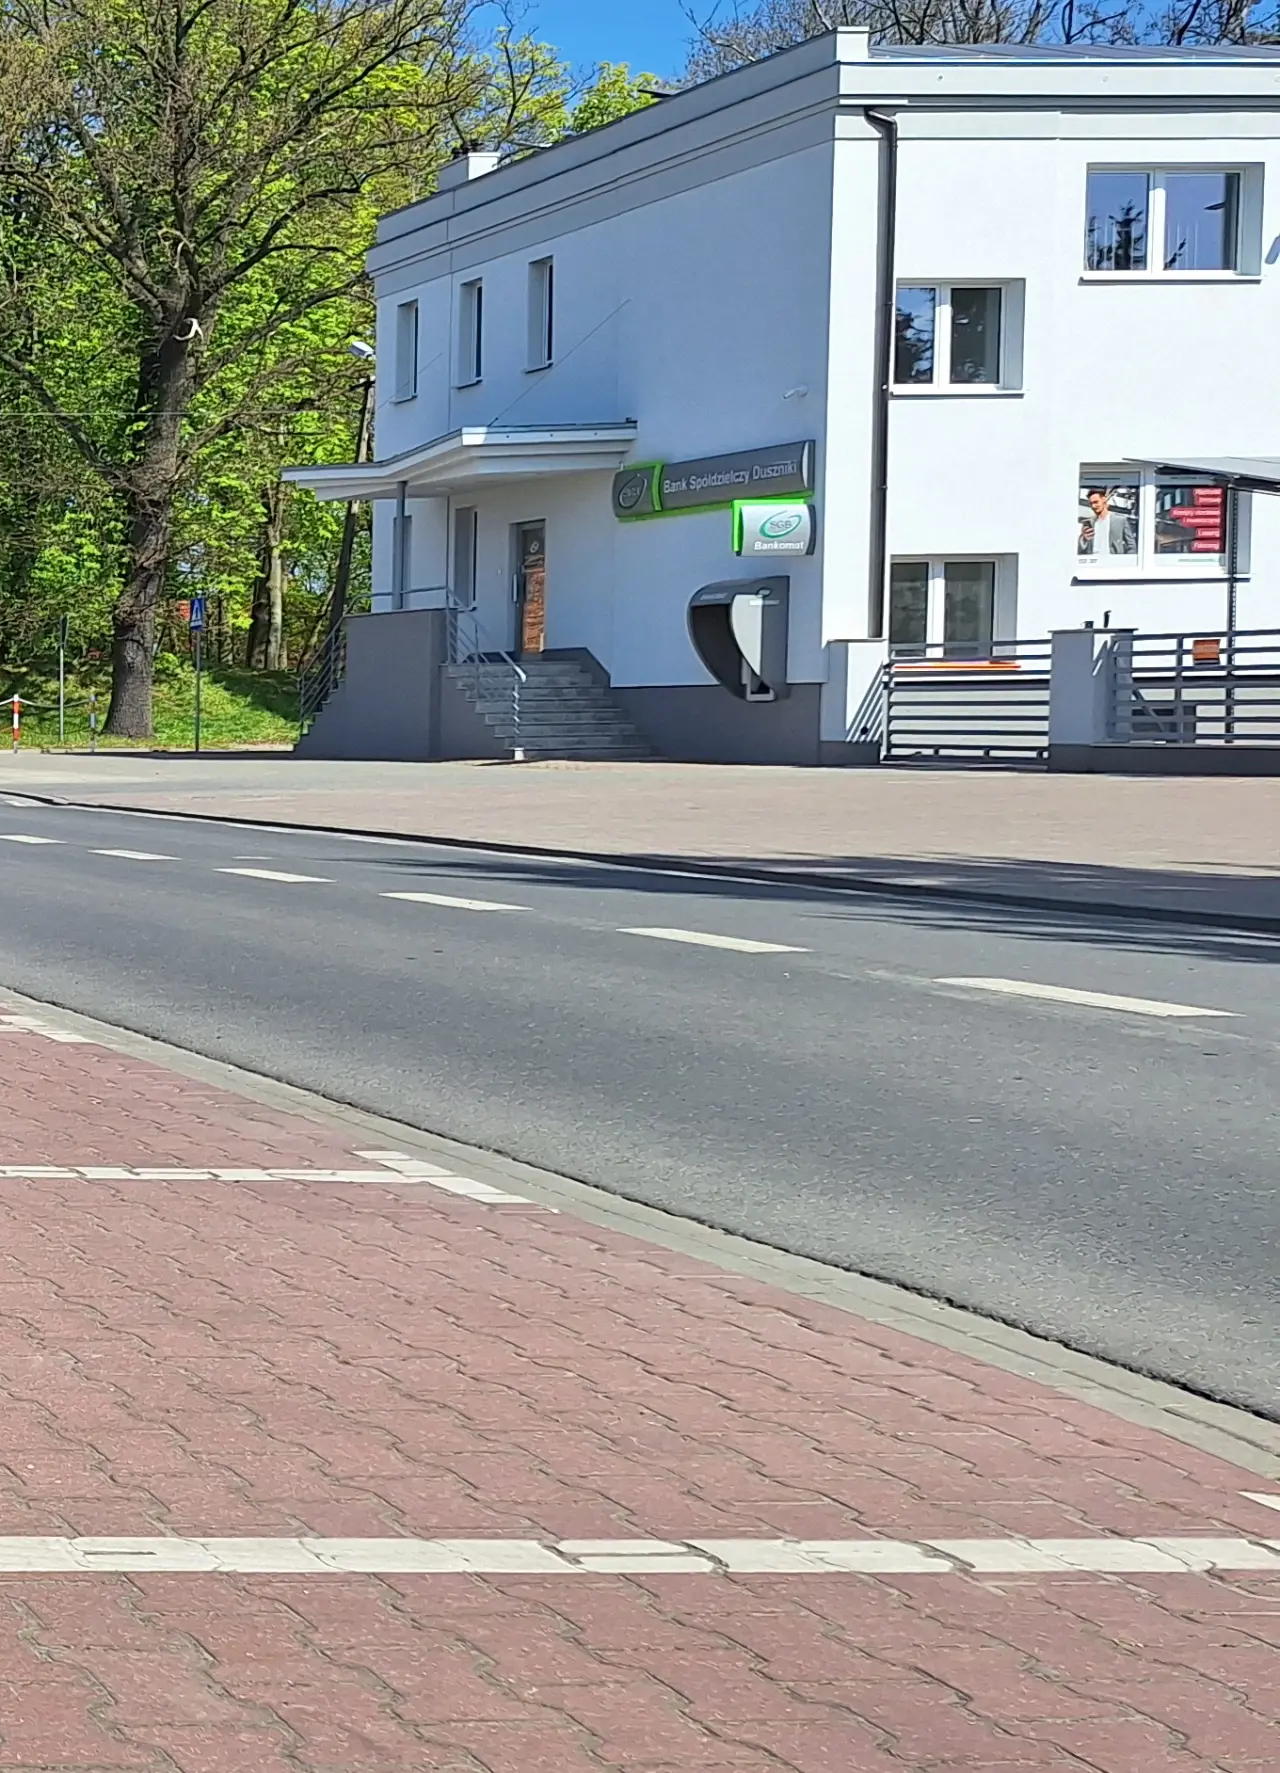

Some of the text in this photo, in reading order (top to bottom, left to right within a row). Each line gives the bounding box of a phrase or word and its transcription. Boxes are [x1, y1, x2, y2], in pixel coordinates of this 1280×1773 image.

[663, 479, 688, 494] Bank
[752, 459, 798, 480] Duszniki
[769, 520, 792, 529] SGB
[753, 540, 805, 550] Bankomat
